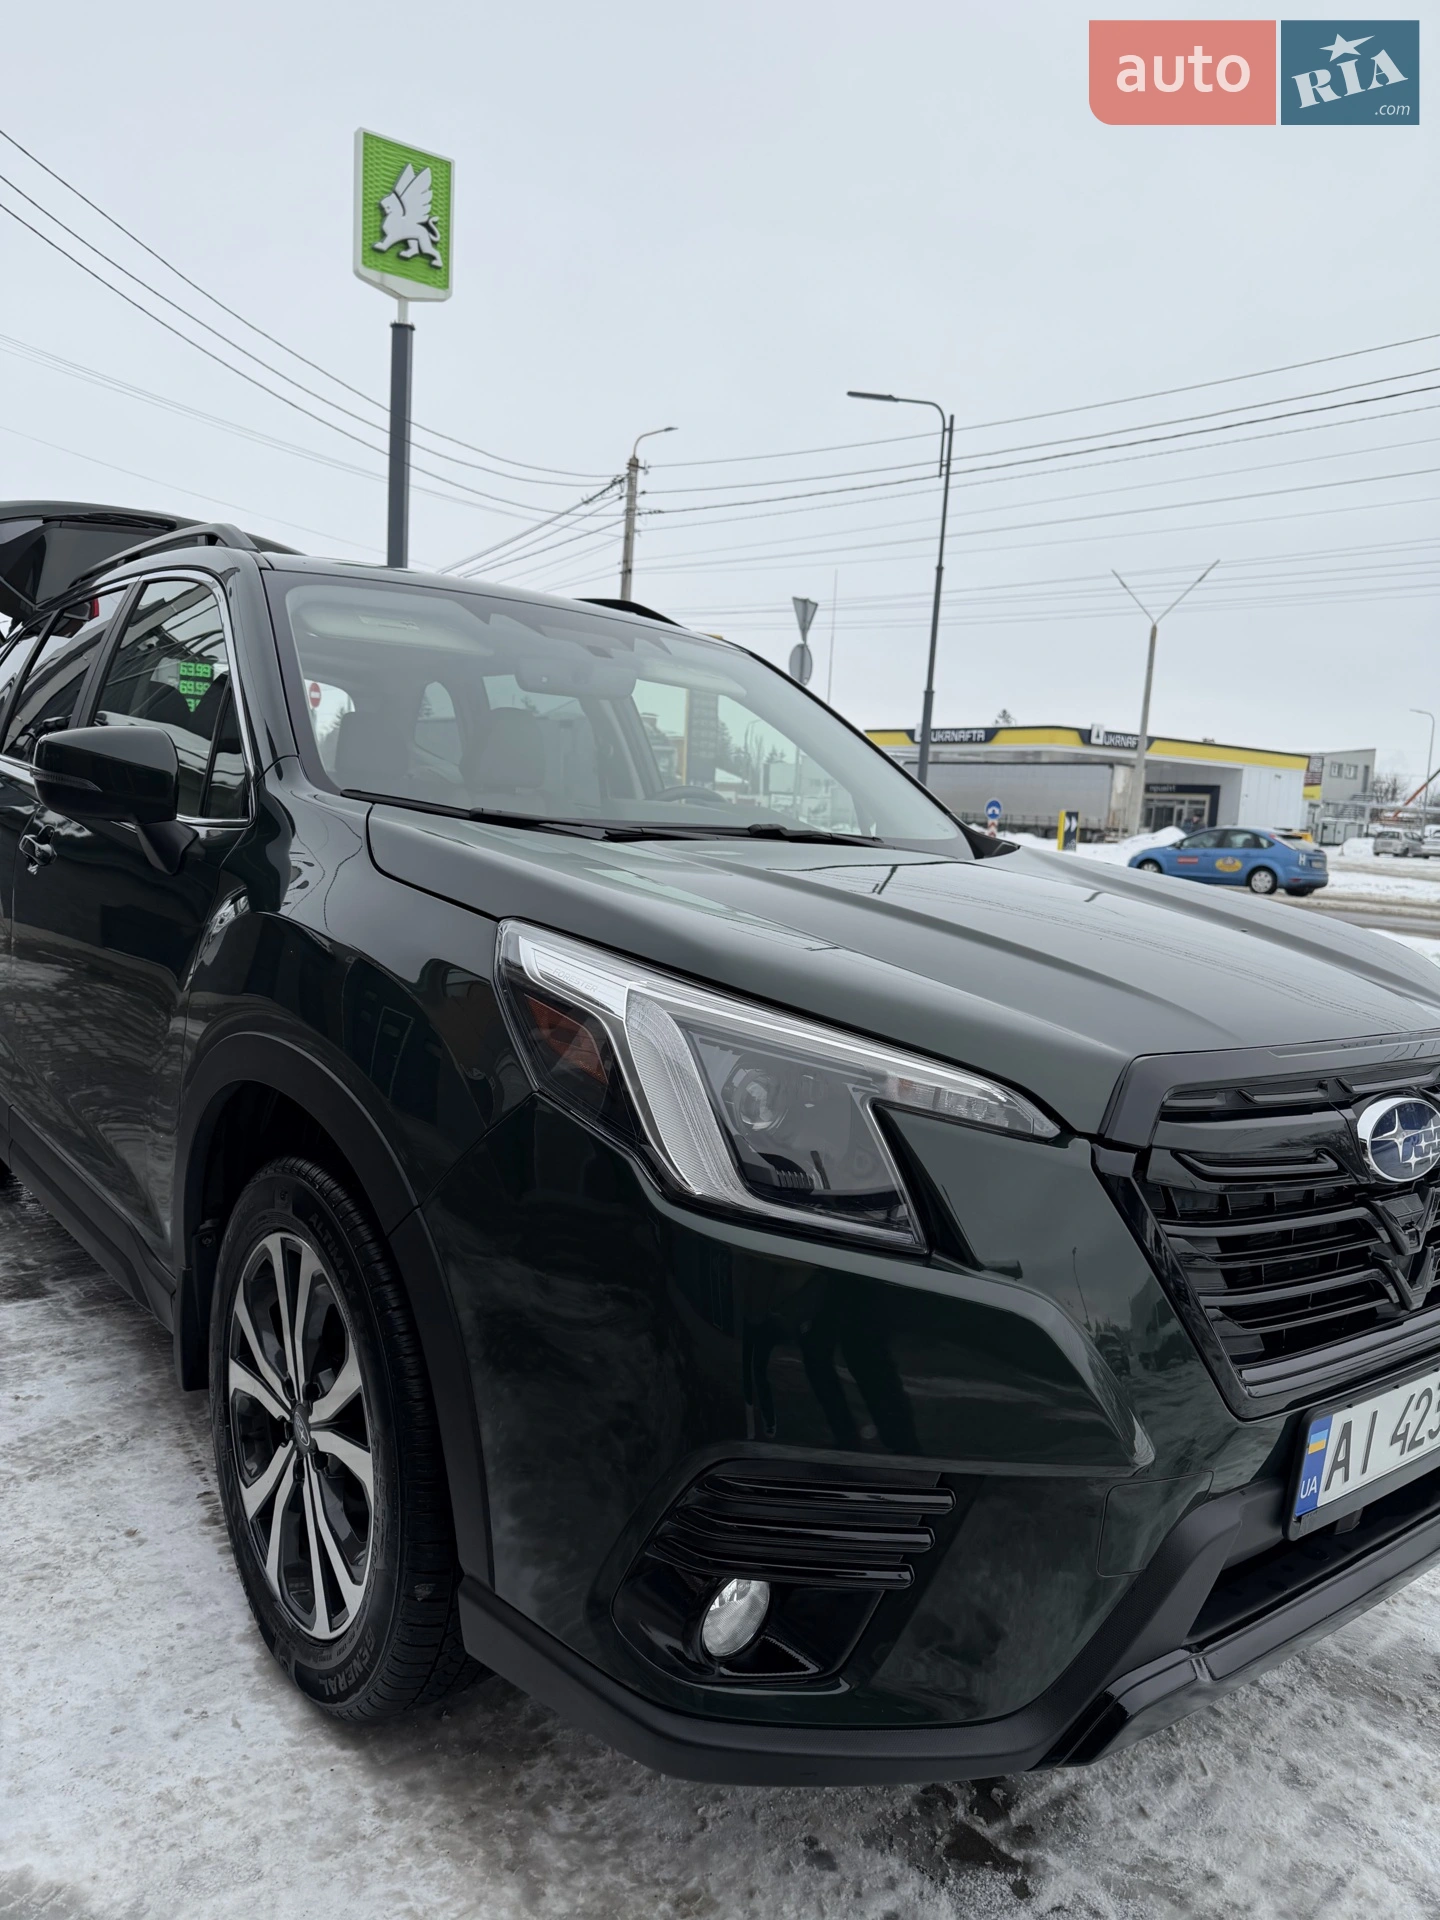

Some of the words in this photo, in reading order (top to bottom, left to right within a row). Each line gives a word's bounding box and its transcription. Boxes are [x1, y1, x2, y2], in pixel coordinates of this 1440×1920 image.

[930, 729, 986, 742] UKRNAFTA
[1103, 733, 1140, 748] UKRNAF
[552, 967, 598, 993] FORESTER
[308, 1212, 357, 1300] ALTIMAX
[1324, 1409, 1379, 1492] AI
[1300, 1475, 1318, 1499] UA
[318, 1626, 376, 1696] GENERAL
